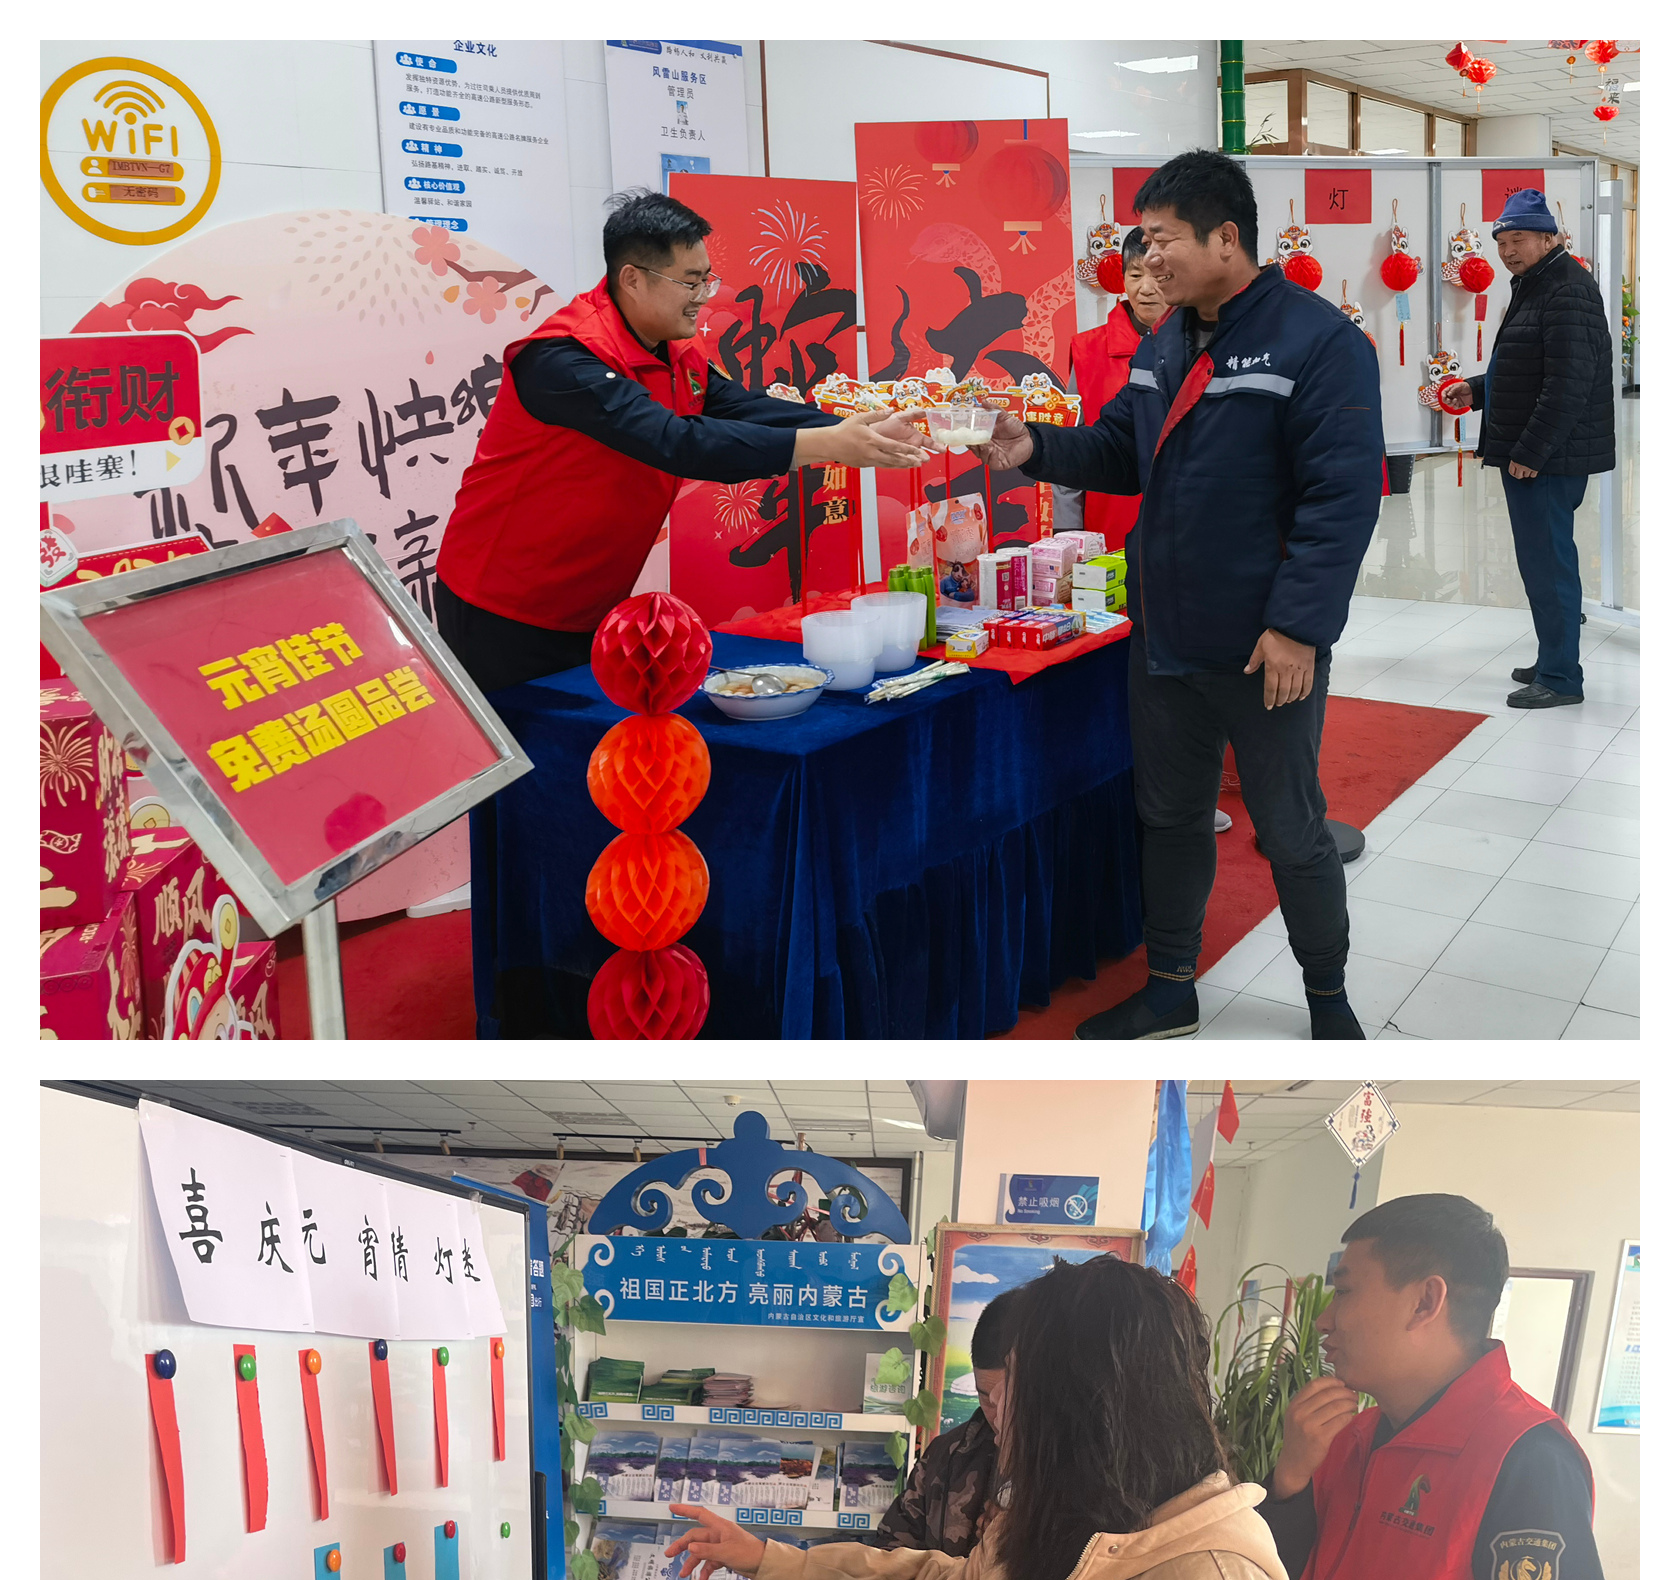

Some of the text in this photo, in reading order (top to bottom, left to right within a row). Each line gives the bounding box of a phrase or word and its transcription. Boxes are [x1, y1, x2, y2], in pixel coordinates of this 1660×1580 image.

[453, 40, 498, 57] 企业文化
[667, 85, 694, 99] 管理员
[661, 126, 706, 141] 卫生负责人
[420, 142, 443, 154] 精神
[122, 184, 160, 199] 无密码
[423, 180, 460, 192] 核心价值观
[1328, 187, 1349, 210] 灯
[198, 622, 364, 710] 元宵佳节
[207, 665, 436, 792] 免费汤圆品尝
[1017, 1195, 1060, 1208] 禁止吸烟
[620, 1277, 869, 1309] 祖国正北方 亮丽内蒙古
[767, 1311, 865, 1324] 内蒙古自治区文化和旅游厅宣
[1500, 1536, 1558, 1551] 内蒙古交通集团
